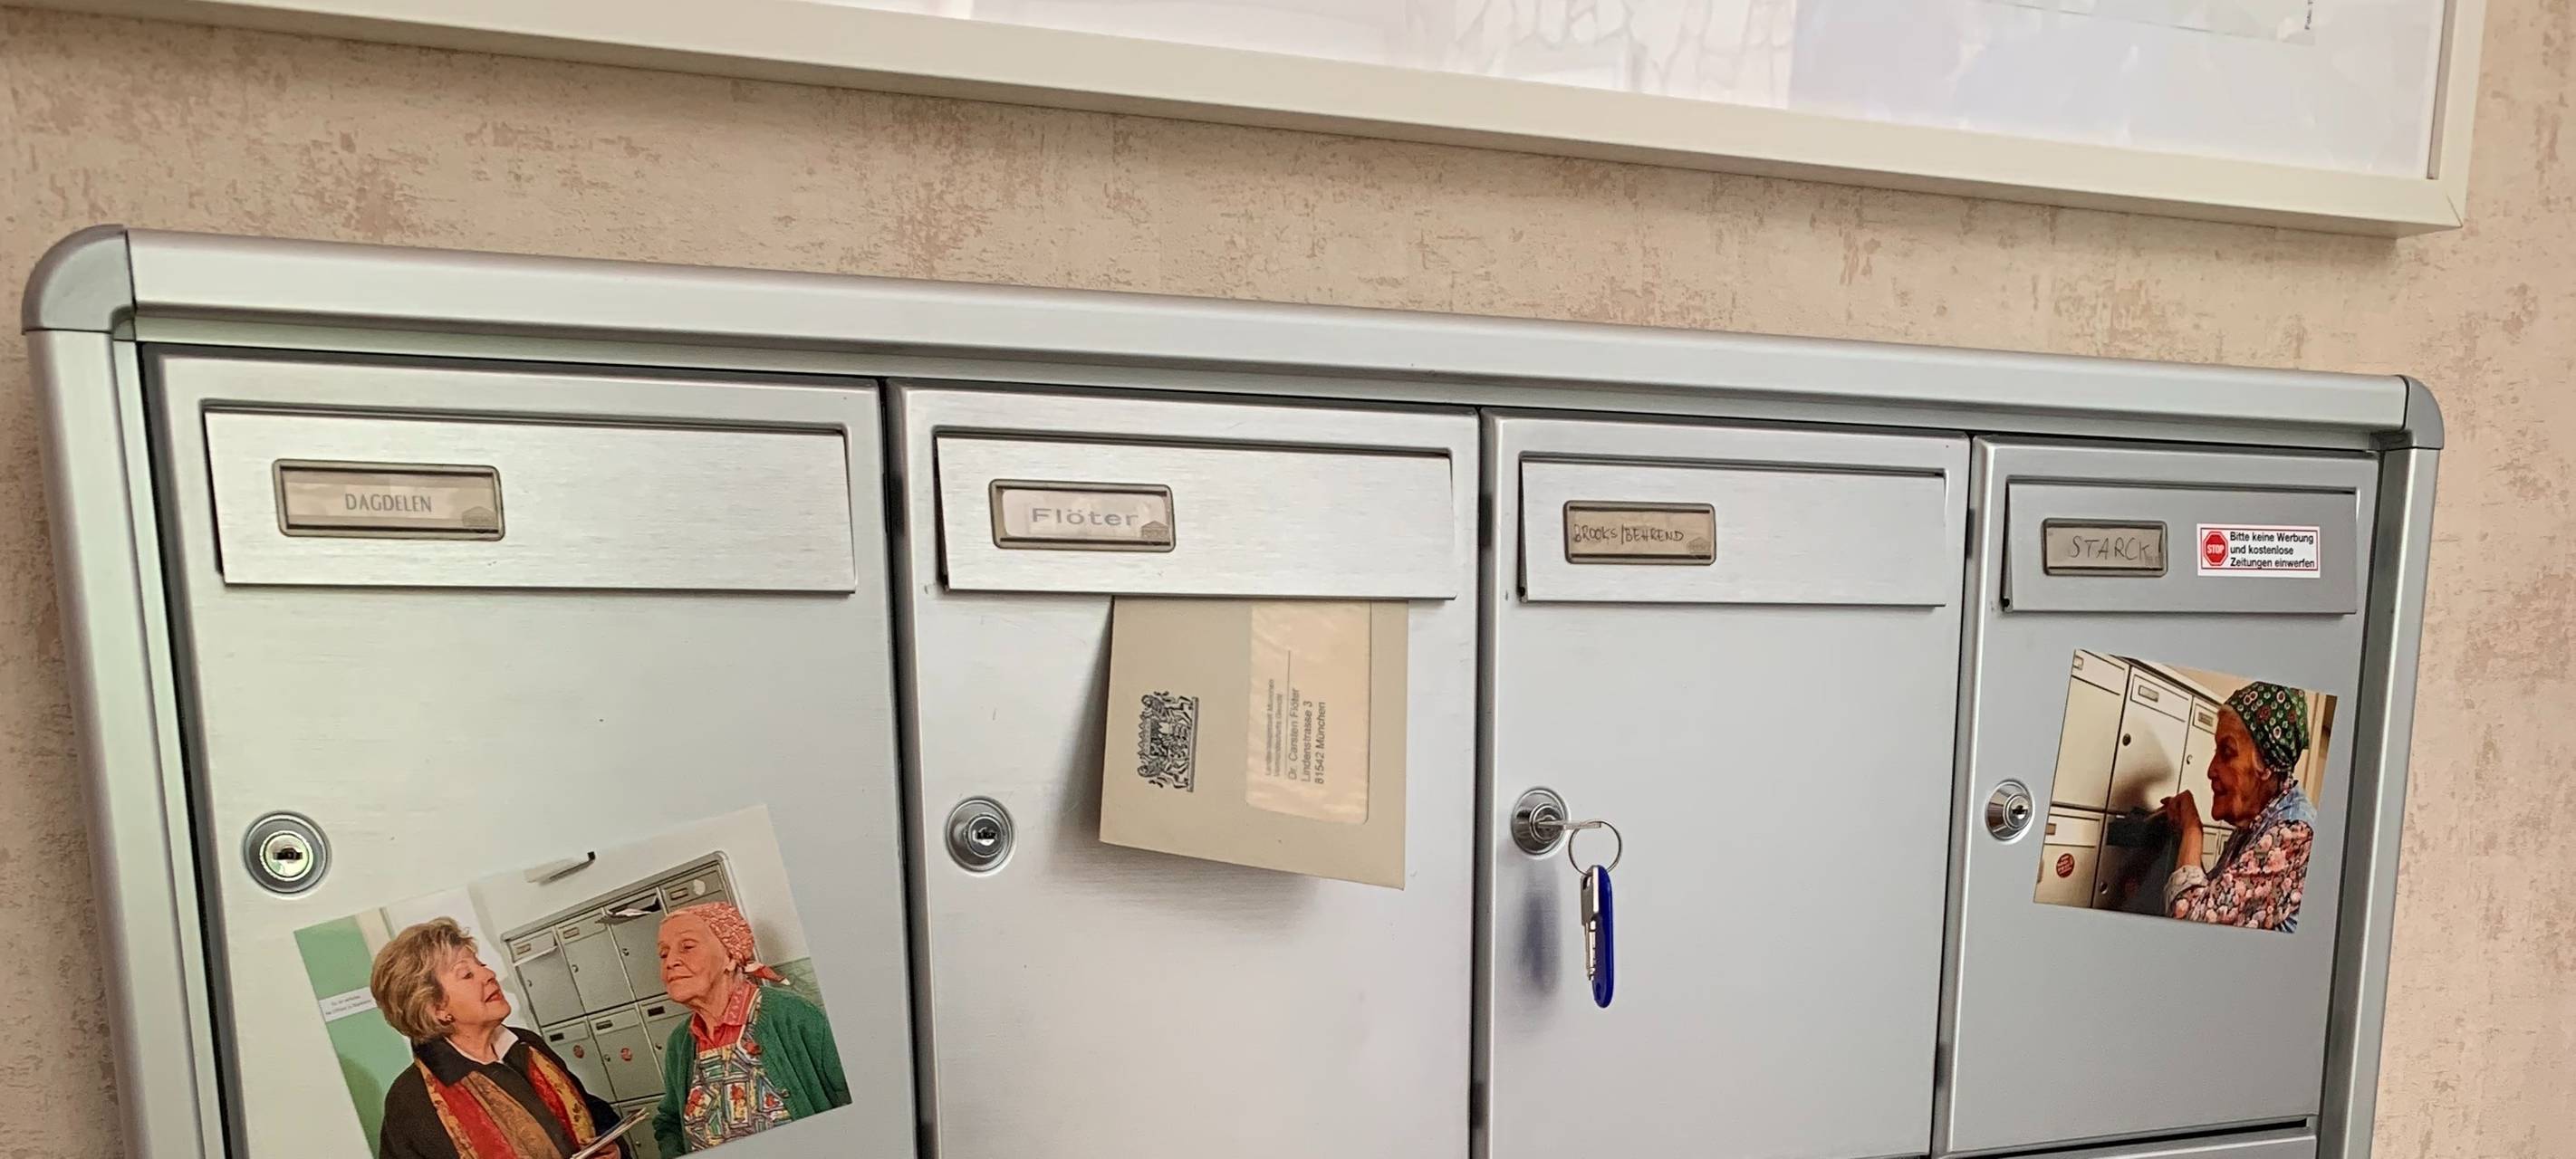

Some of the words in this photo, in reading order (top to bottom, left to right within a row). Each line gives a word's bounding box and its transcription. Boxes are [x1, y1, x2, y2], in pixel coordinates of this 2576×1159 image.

[344, 493, 432, 512] DAGDELEN
[1031, 507, 1139, 526] Flöter
[2069, 535, 2150, 560] STARCK
[2230, 532, 2250, 541] Bitte
[2252, 532, 2274, 542] keine
[2276, 532, 2314, 545] Werbung
[2206, 544, 2225, 554] STOP
[2230, 545, 2246, 554] und
[2248, 545, 2293, 555] kostenlose
[2230, 557, 2273, 569] Zeitungen
[2274, 558, 2315, 569] einwerfen
[1290, 688, 1300, 718] Flöter
[1302, 700, 1313, 708] 3
[1315, 702, 1326, 750] München
[1288, 720, 1299, 761] Carsten
[1301, 709, 1312, 782] Lindenstrasse
[1314, 752, 1325, 784] 81542
